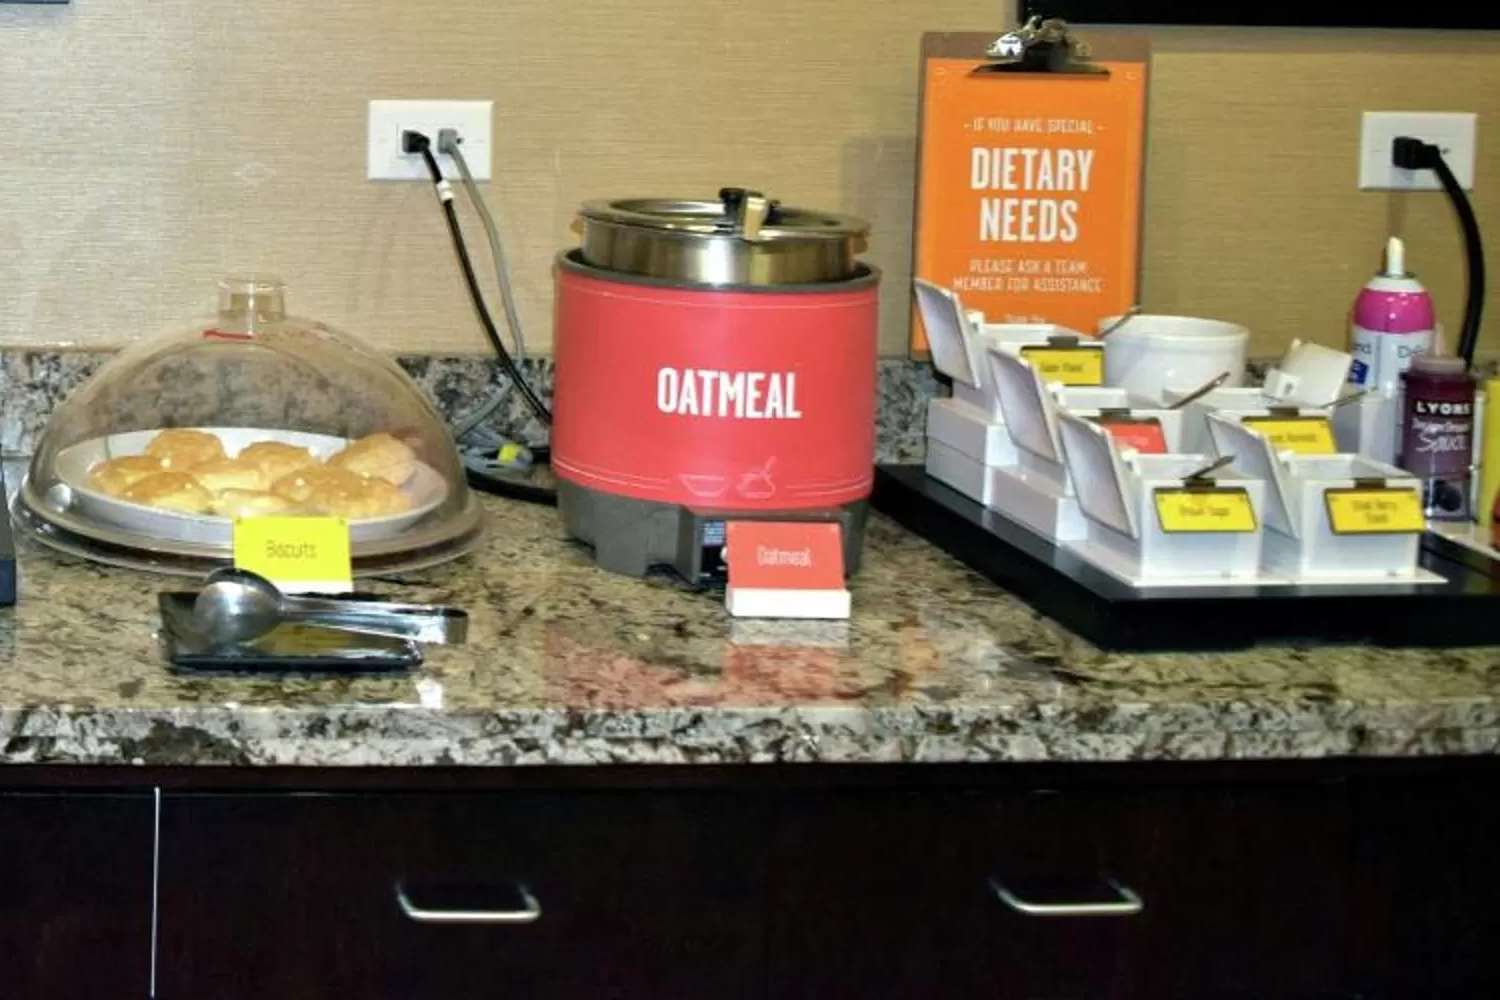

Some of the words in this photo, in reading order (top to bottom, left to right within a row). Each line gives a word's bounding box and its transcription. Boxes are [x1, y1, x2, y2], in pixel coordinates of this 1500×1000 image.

[1047, 119, 1093, 134] SPECIAL
[970, 147, 1096, 192] DIETARY
[979, 198, 1080, 243] NEEDS
[970, 259, 1013, 273] PLEASE
[1018, 260, 1040, 273] ASK
[1056, 260, 1088, 274] TEAM
[953, 276, 1002, 292] MEMBER
[1008, 277, 1030, 292] FOR
[1034, 278, 1102, 293] ASSISTANCE
[657, 367, 803, 419] OATMEAL
[756, 544, 812, 568] Oatmeal
